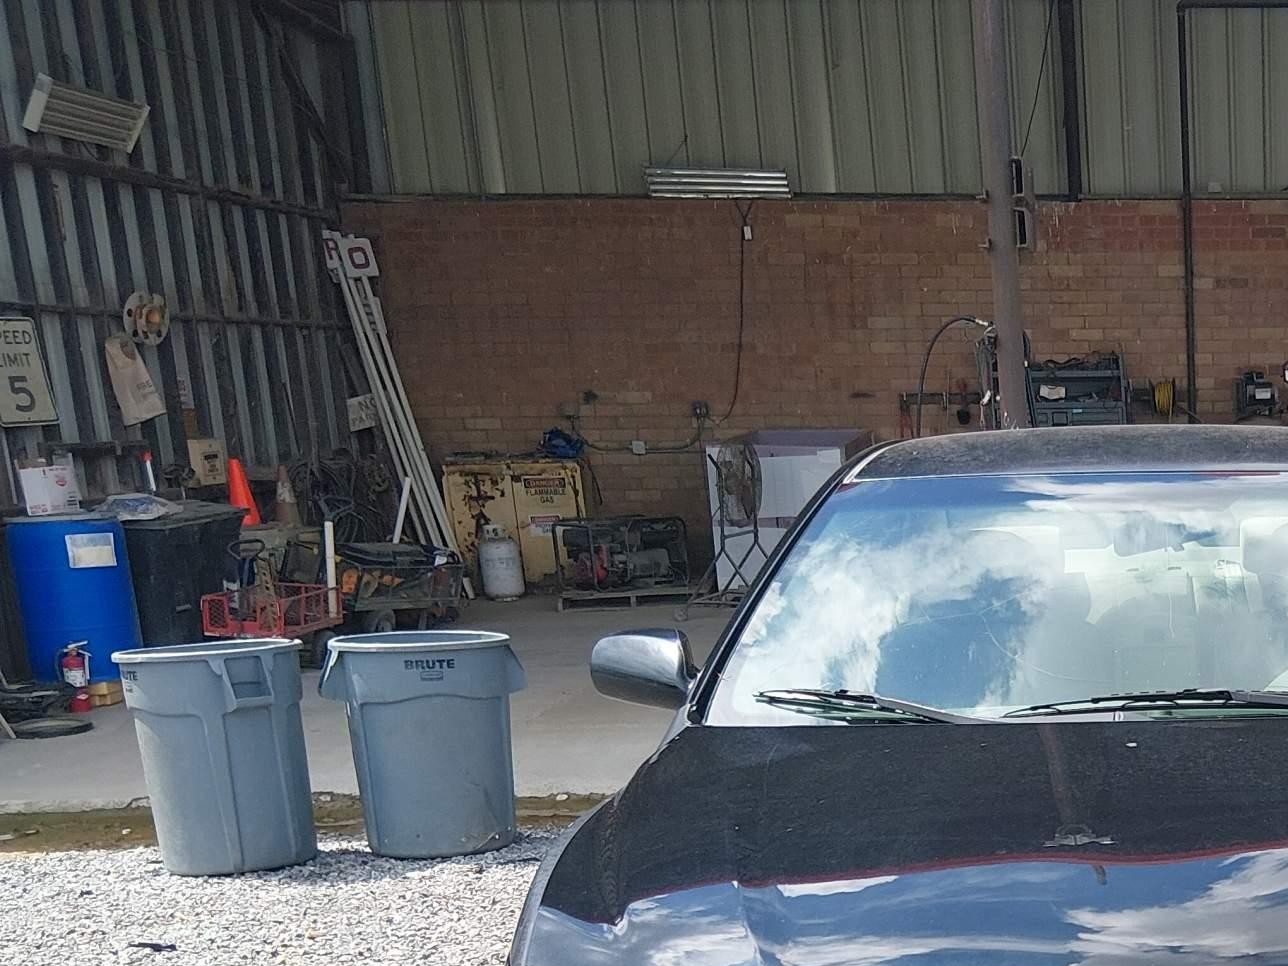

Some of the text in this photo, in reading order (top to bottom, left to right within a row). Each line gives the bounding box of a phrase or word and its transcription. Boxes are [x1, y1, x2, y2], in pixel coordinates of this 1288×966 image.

[0, 329, 32, 345] EED
[8, 375, 36, 413] 5
[526, 487, 567, 496] FLAMMABLE
[540, 496, 555, 504] GAS
[404, 658, 456, 670] BRUTE
[121, 669, 139, 681] UTE
